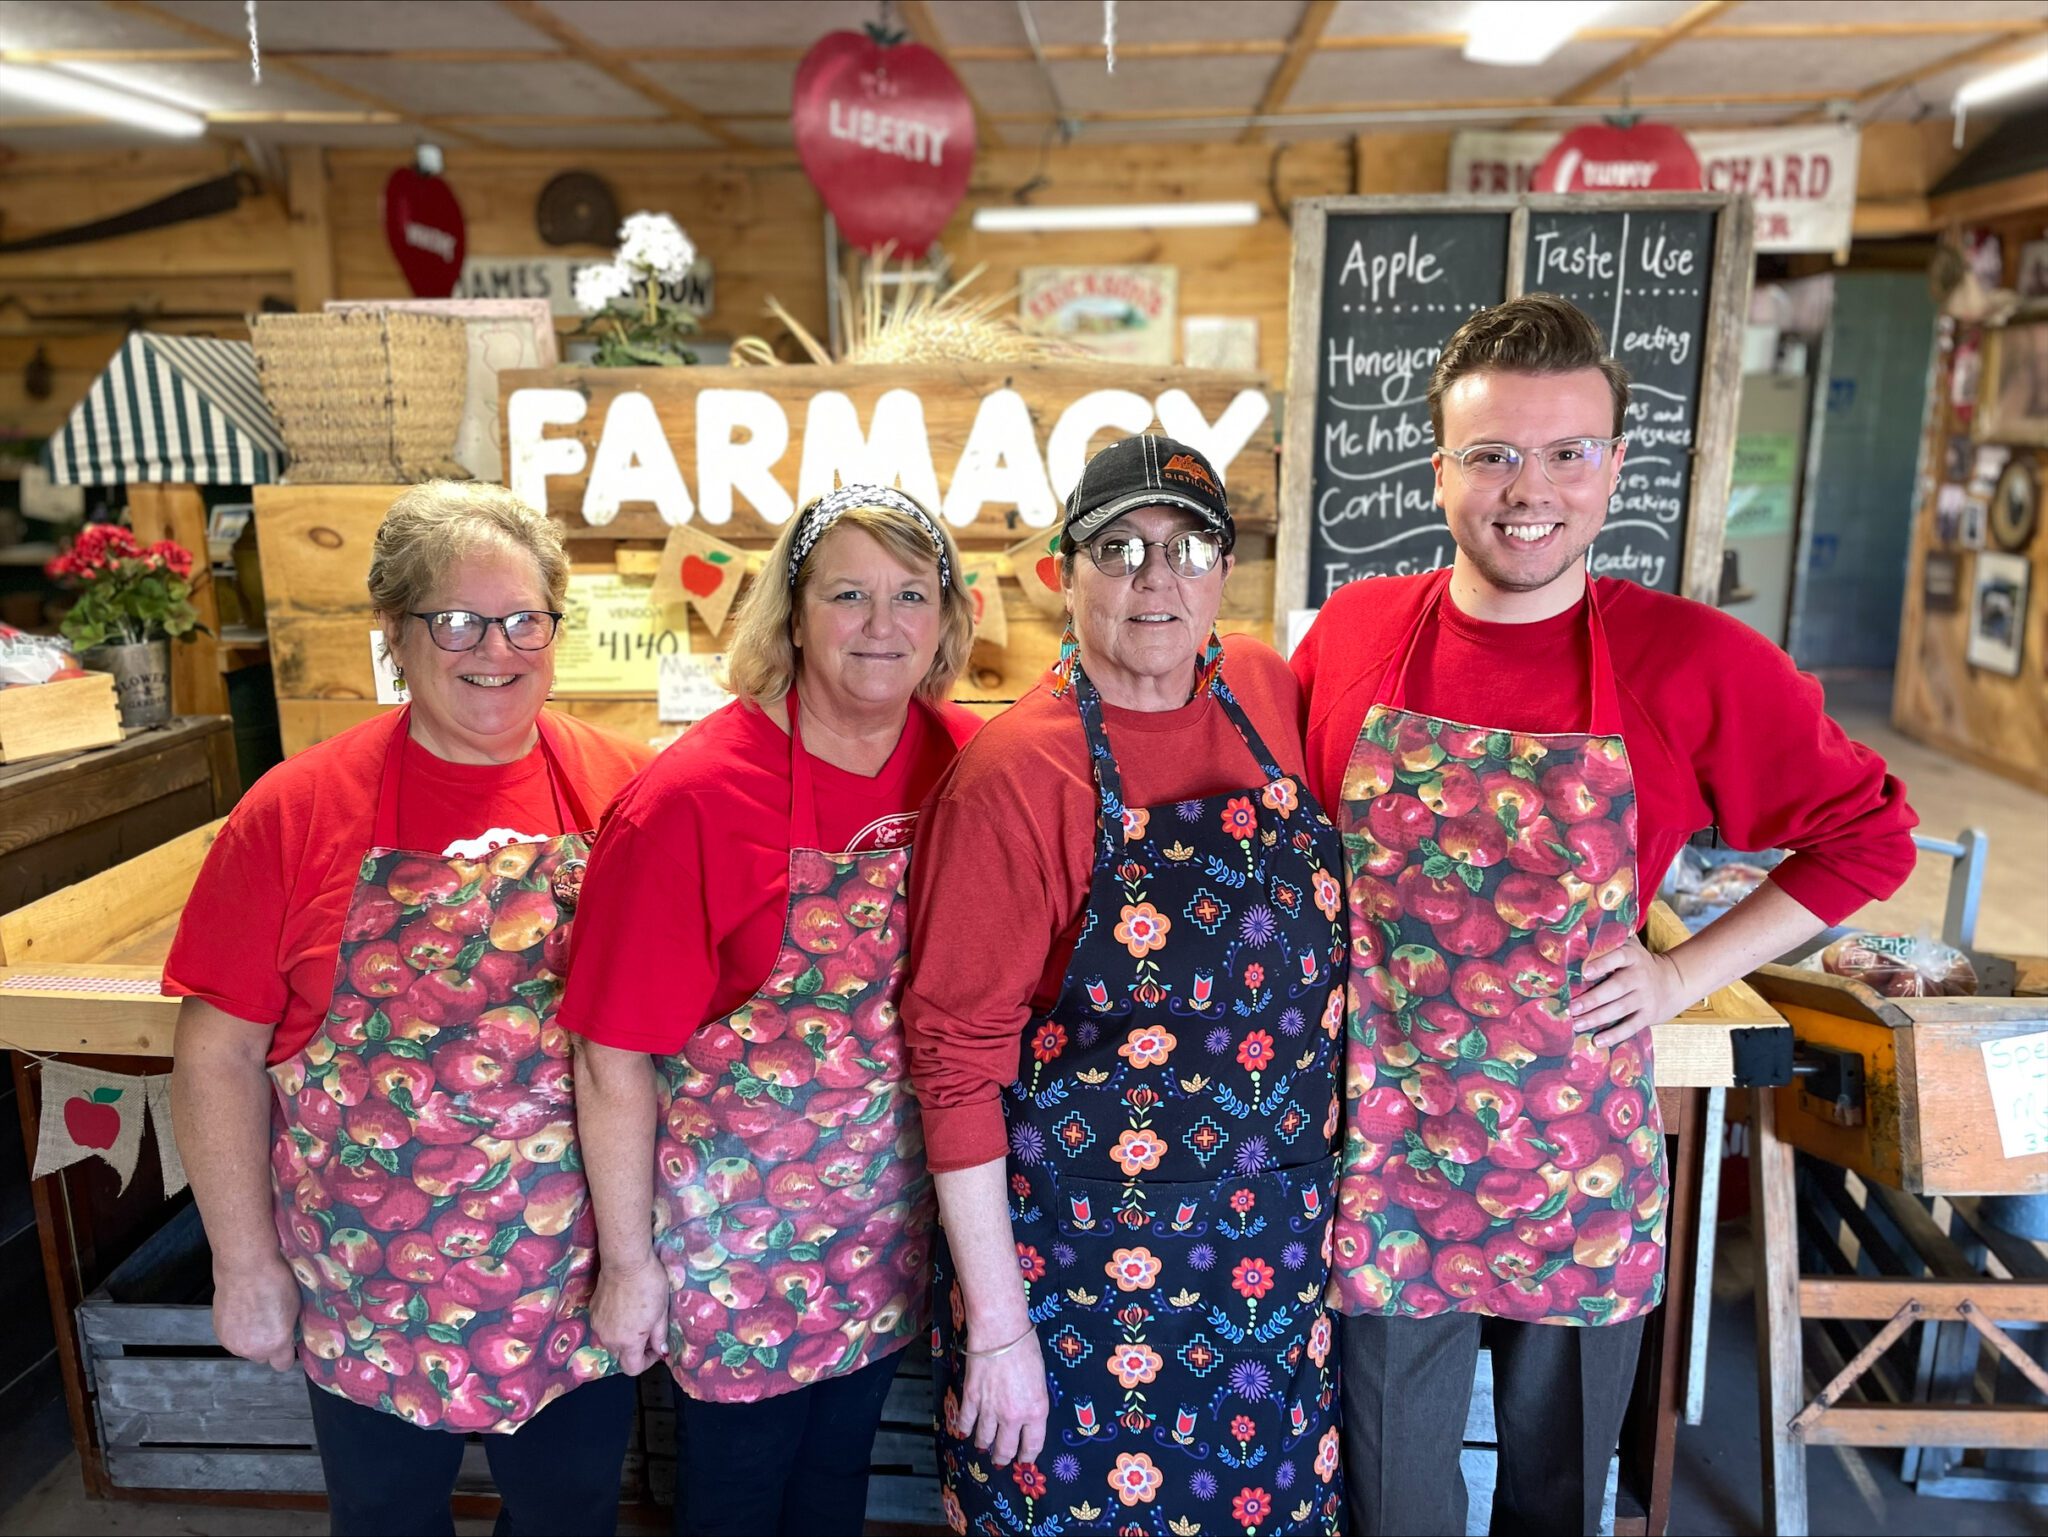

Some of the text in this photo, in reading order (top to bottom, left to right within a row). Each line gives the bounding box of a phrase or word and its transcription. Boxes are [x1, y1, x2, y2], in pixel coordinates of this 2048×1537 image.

[829, 98, 949, 167] LIBERTY
[1706, 153, 1833, 200] CHARD
[1339, 233, 1444, 302] Apple
[1535, 231, 1614, 285] Taste
[1641, 235, 1694, 279] Use
[1623, 324, 1692, 365] eating
[1325, 411, 1436, 458] McIntos
[1652, 404, 1685, 423] and
[508, 388, 1270, 527] FARMACY
[1653, 470, 1683, 490] and
[1609, 496, 1681, 523] Baking
[1593, 544, 1666, 586] eating
[598, 628, 679, 661] 4140
